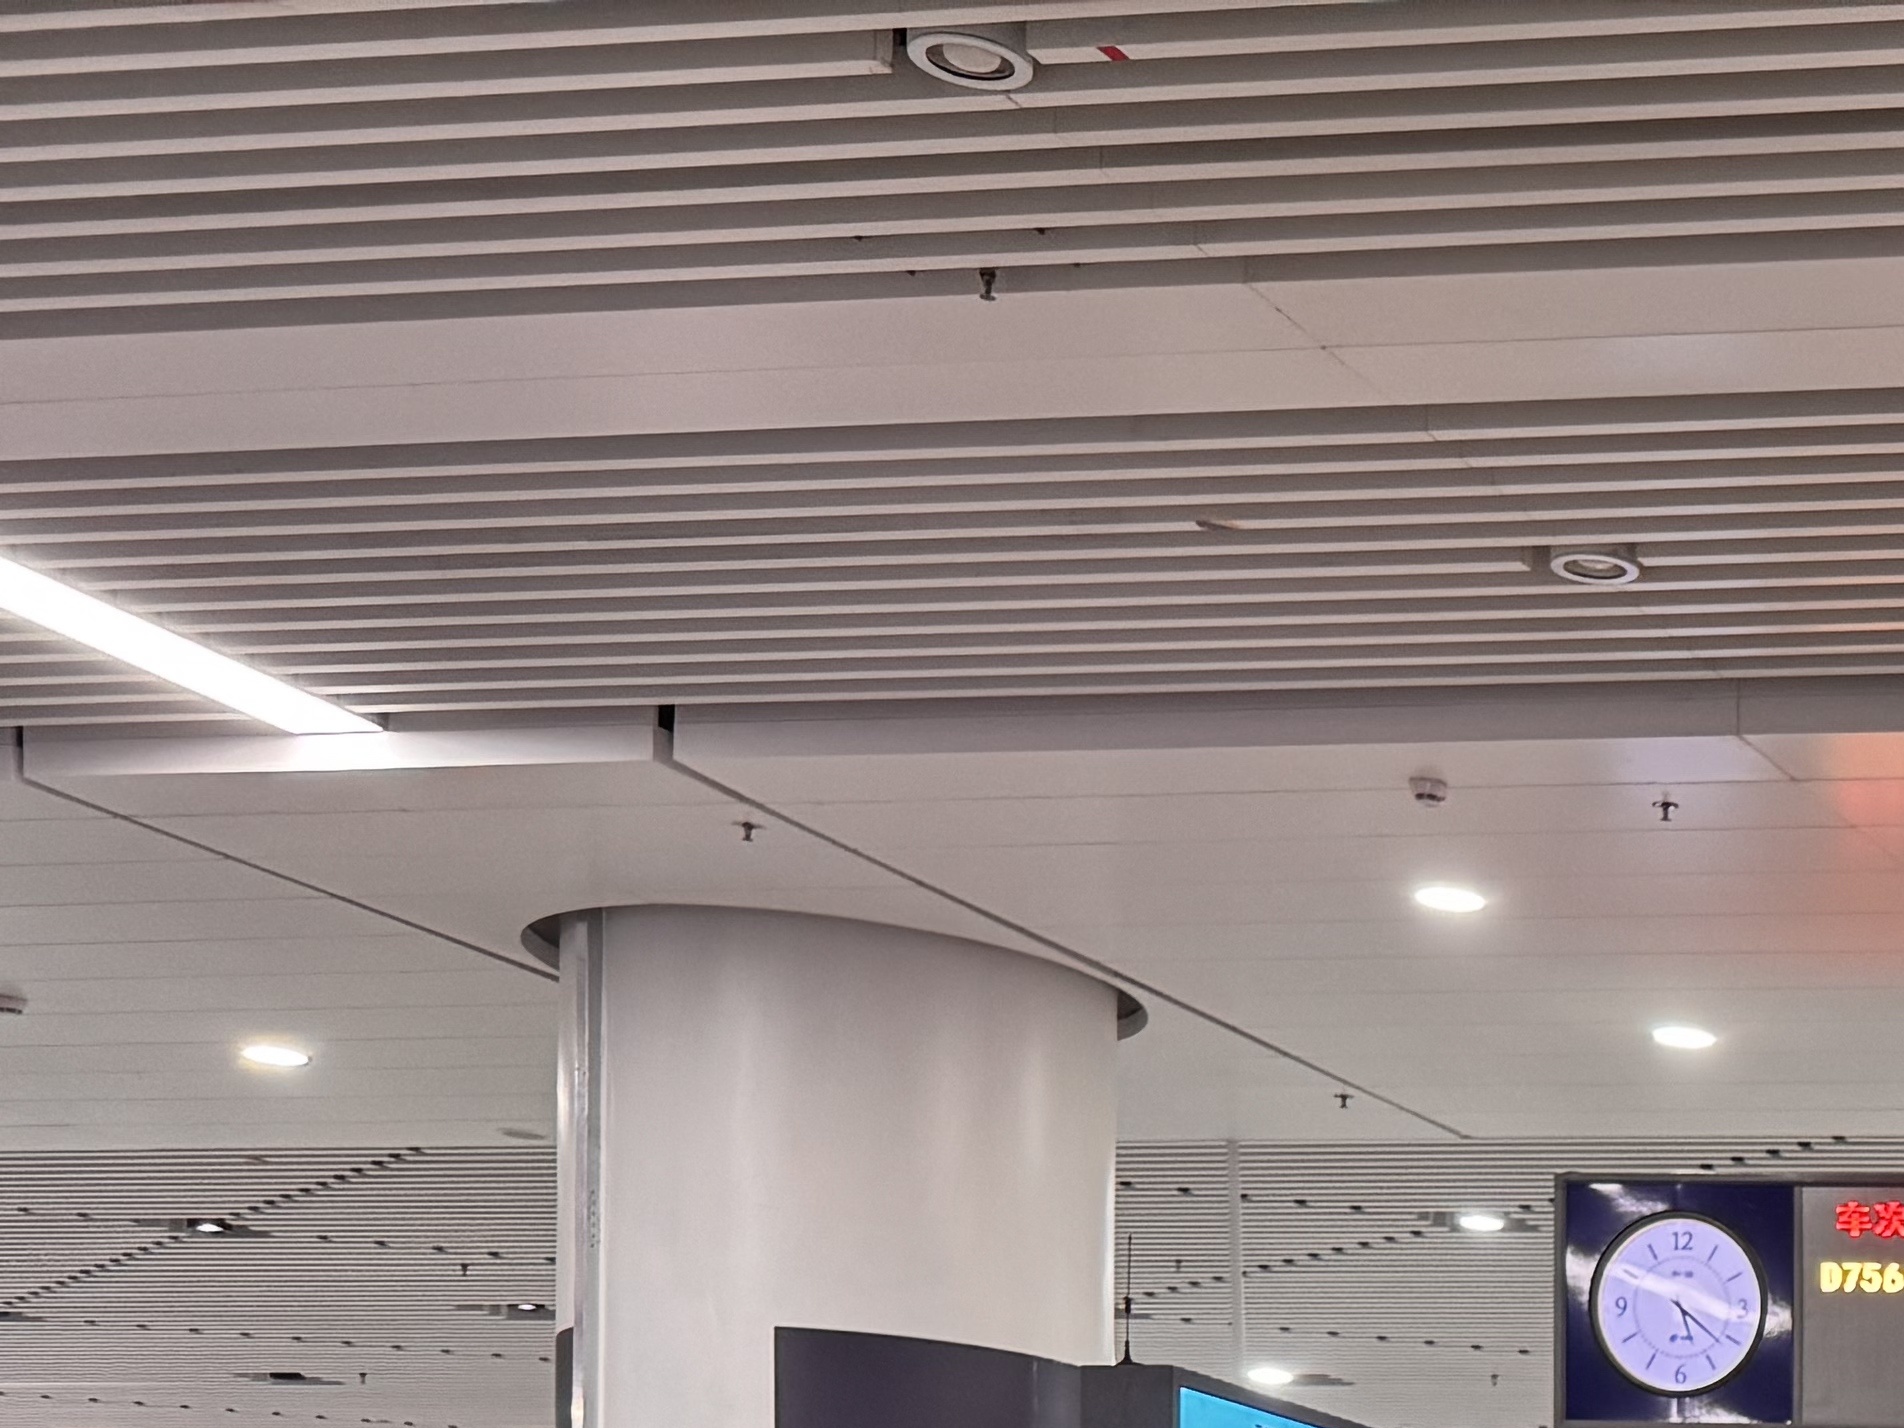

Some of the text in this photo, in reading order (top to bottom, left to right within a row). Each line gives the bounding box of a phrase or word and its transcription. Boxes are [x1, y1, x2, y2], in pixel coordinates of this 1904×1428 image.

[1672, 1232, 1693, 1251] 12
[1615, 1297, 1627, 1317] 9
[1738, 1299, 1748, 1319] 3
[1675, 1364, 1686, 1384] 6
